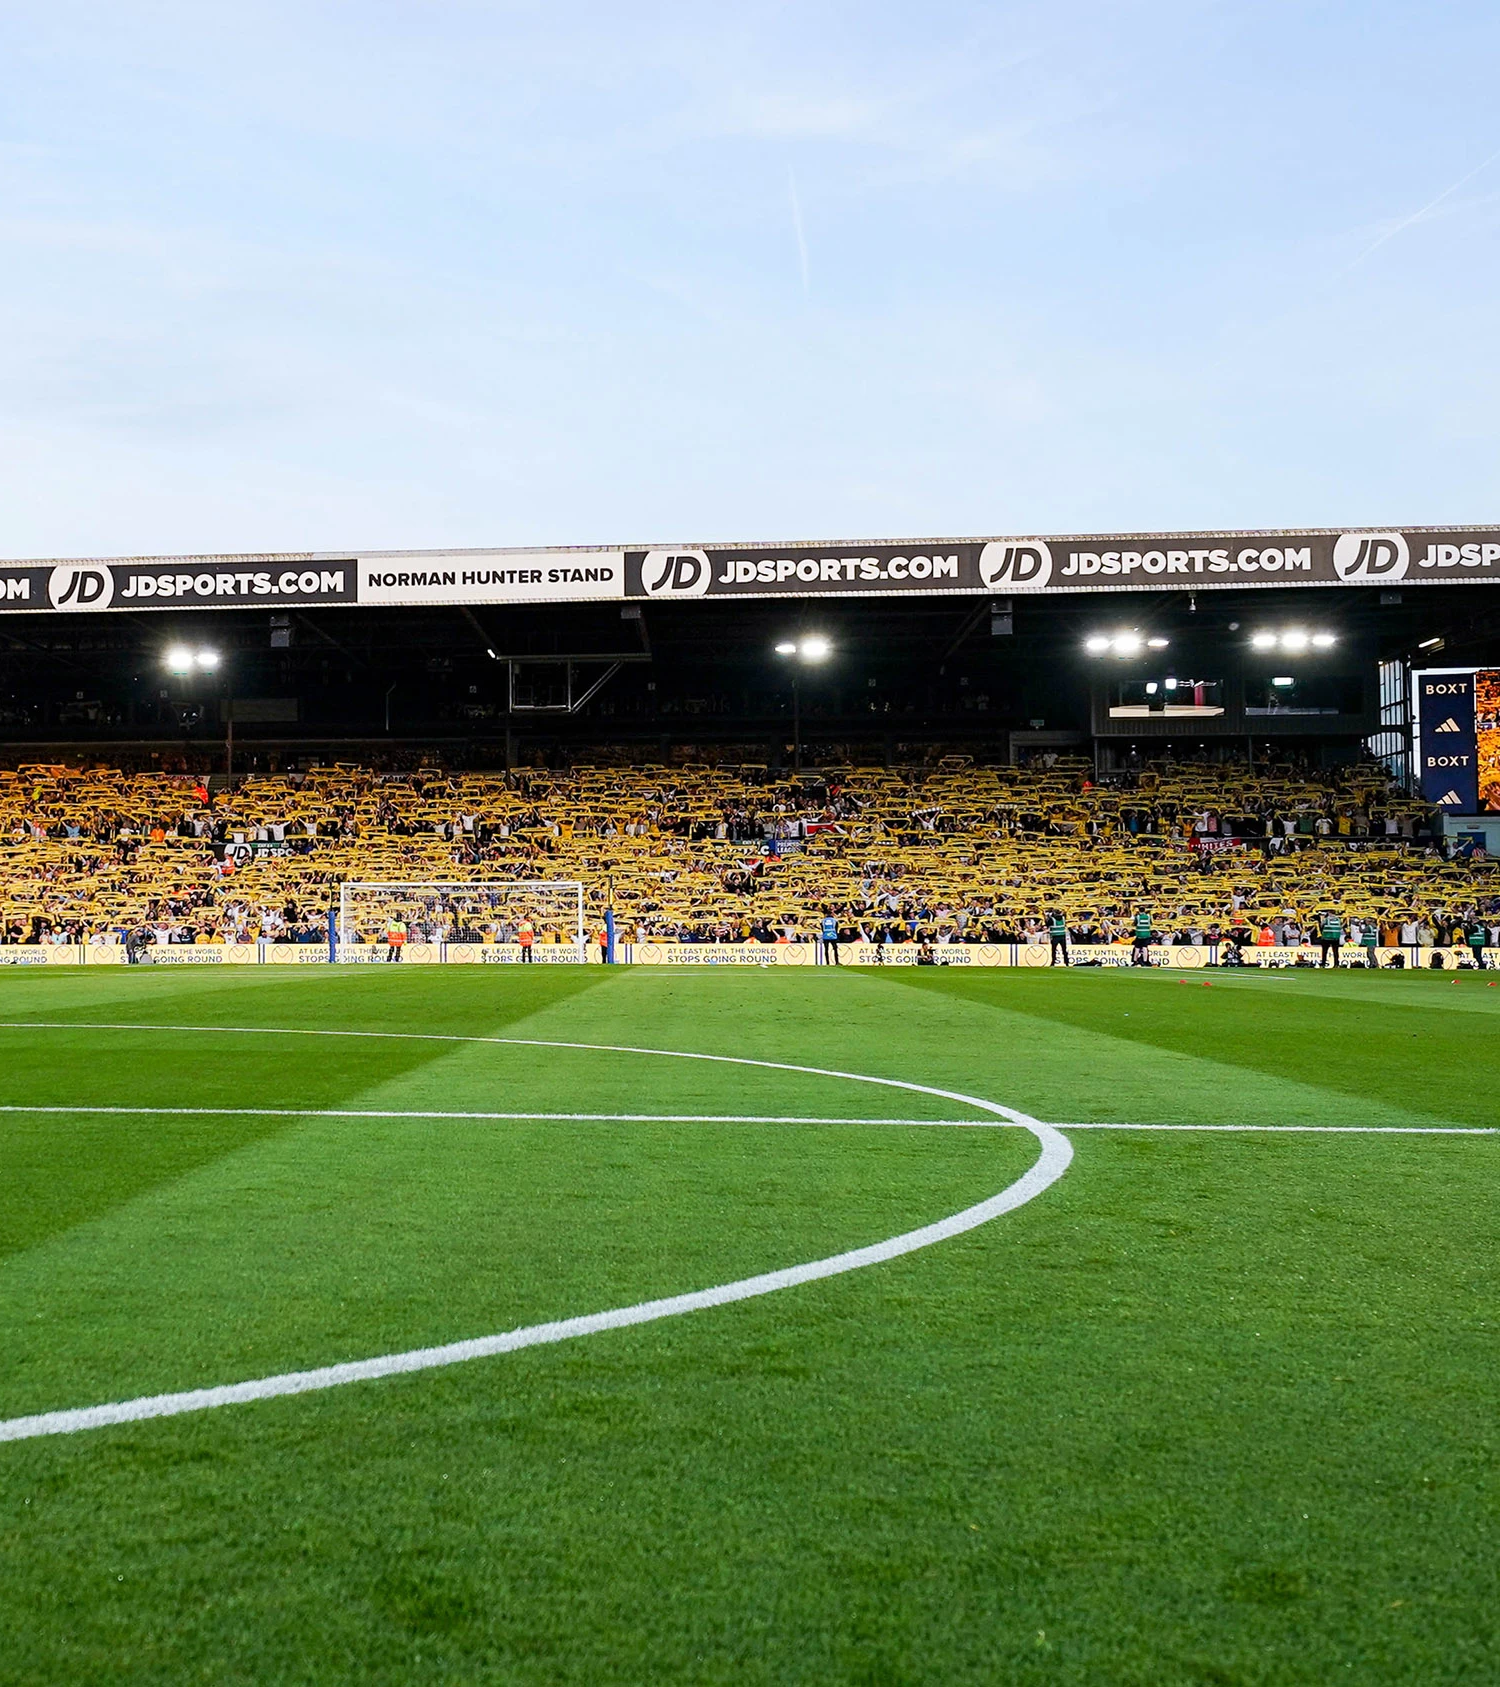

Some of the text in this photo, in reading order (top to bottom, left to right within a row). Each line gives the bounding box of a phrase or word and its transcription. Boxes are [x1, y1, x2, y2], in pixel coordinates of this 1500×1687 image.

[652, 554, 959, 589] JD JDSPORTS.COM
[985, 547, 1311, 581] JD JDSPORTS.COM
[1344, 539, 1398, 575] JD
[58, 570, 345, 604] JD JDSPORTS.COM
[368, 567, 614, 588] NORMAN HUNTER STAND
[1426, 683, 1467, 695] BOXT
[1427, 756, 1469, 767] BOXT
